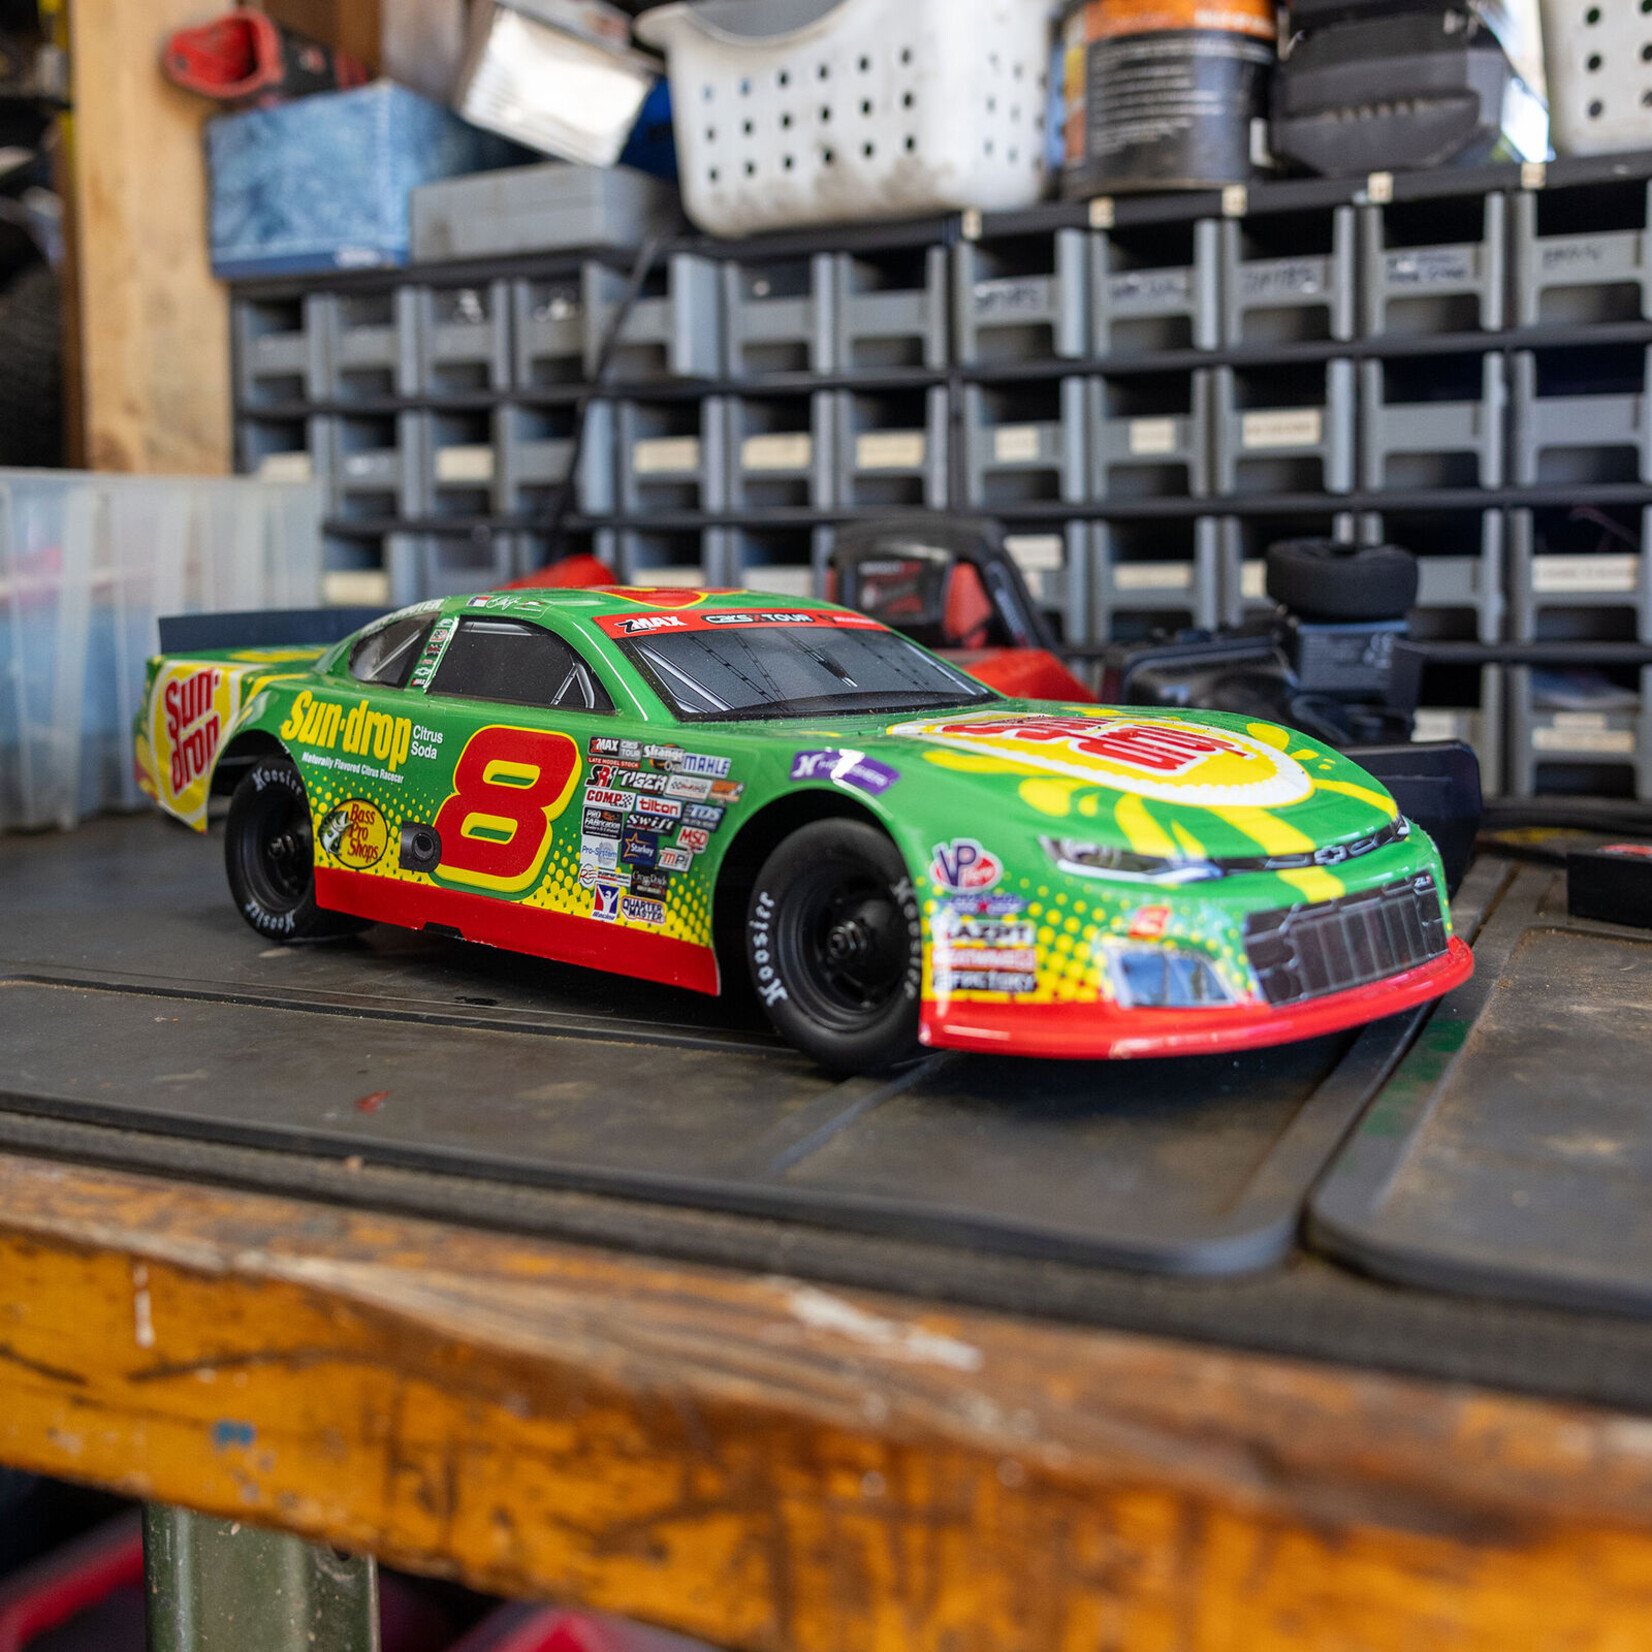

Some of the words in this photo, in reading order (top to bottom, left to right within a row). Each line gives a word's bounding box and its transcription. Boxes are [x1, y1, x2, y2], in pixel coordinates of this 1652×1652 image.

[762, 613, 814, 623] TOUR
[412, 725, 444, 744] Citrus
[411, 741, 438, 760] Soda
[622, 749, 641, 757] TOUR
[301, 751, 334, 770] Naturally
[334, 758, 361, 774] Flavored
[361, 764, 379, 778] Citrus
[380, 768, 404, 784] Racecar
[683, 755, 729, 775] MAHLE
[252, 767, 303, 796] Hoosier
[586, 765, 618, 788] SRI
[618, 769, 668, 790] TIGER
[587, 790, 622, 805] COMP
[639, 797, 679, 816] tilton
[350, 803, 375, 825] Bass
[430, 724, 583, 892] 8
[586, 810, 601, 819] PRO
[349, 822, 369, 841] Pro
[626, 814, 675, 830] Swift
[680, 828, 709, 846] MSD
[347, 838, 379, 863] Shops
[630, 842, 654, 857] Starkey
[939, 845, 977, 888] VP
[623, 898, 663, 910] QUARTER
[629, 907, 663, 920] MASTER
[244, 899, 297, 934] Hoosier
[748, 891, 789, 1007] Hoosier
